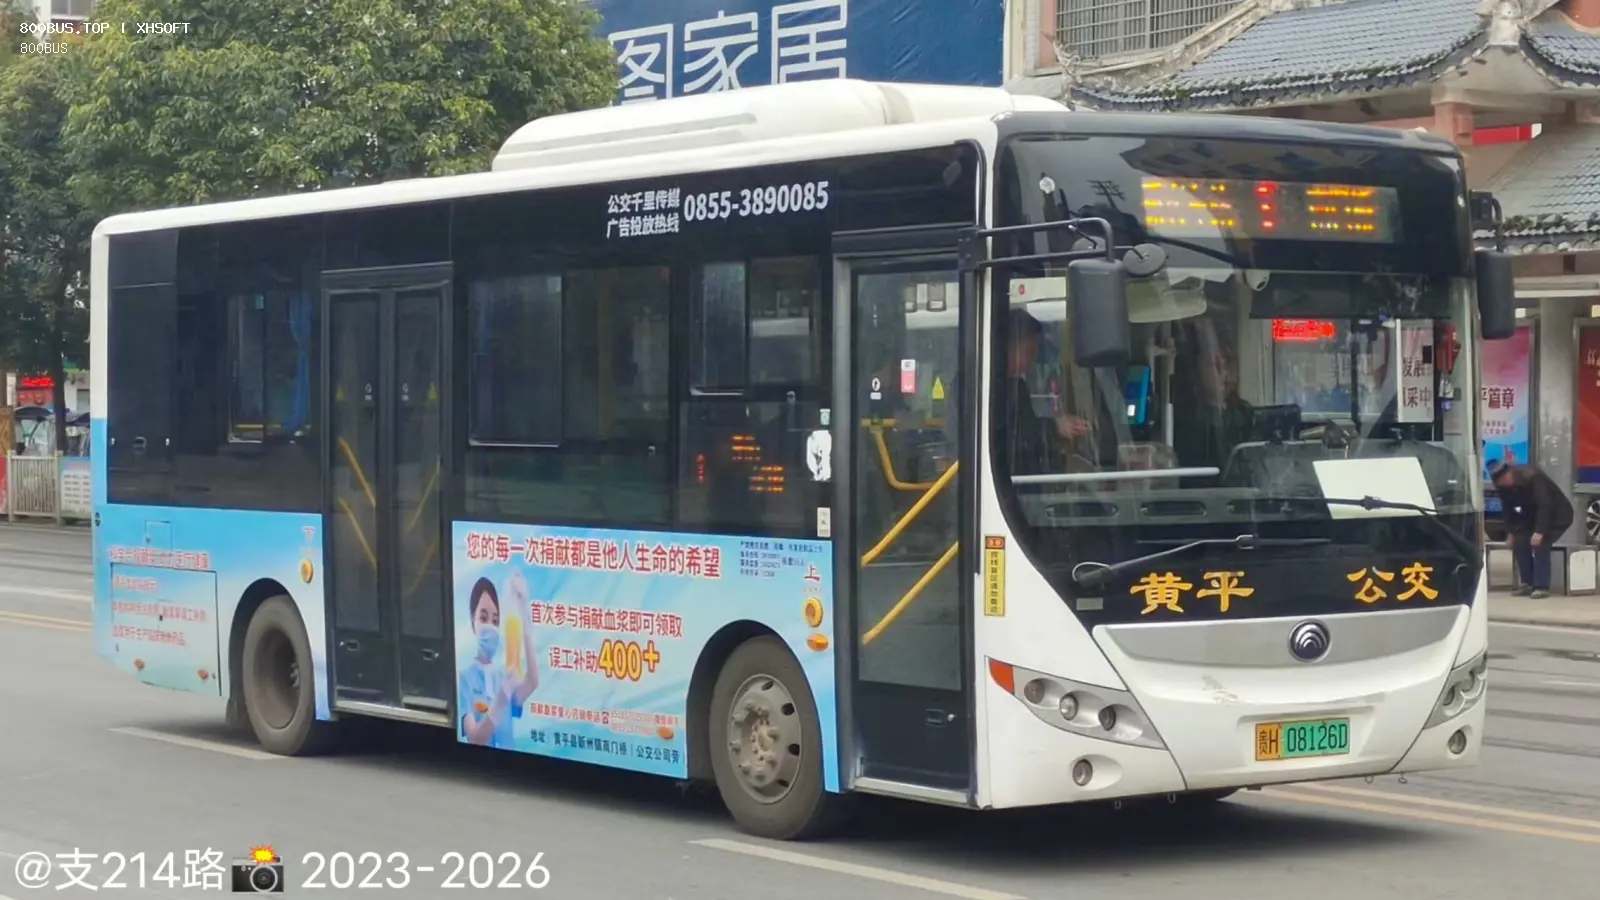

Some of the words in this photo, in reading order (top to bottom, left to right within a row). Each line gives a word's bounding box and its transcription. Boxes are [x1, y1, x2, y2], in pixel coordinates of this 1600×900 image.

[607, 187, 681, 214] 公交千里传媒
[684, 180, 829, 222] 0855-3890085
[606, 212, 680, 239] 广告投放热线
[467, 532, 721, 578] 您的每一次捐献都是他人生命的希望
[804, 564, 821, 582] 上
[1130, 571, 1255, 615] 黄平
[1346, 561, 1439, 603] 公交
[530, 602, 683, 638] 首次参与捐献血浆即可领取
[1258, 727, 1279, 756] 贵H
[1286, 723, 1348, 753] 08126D
